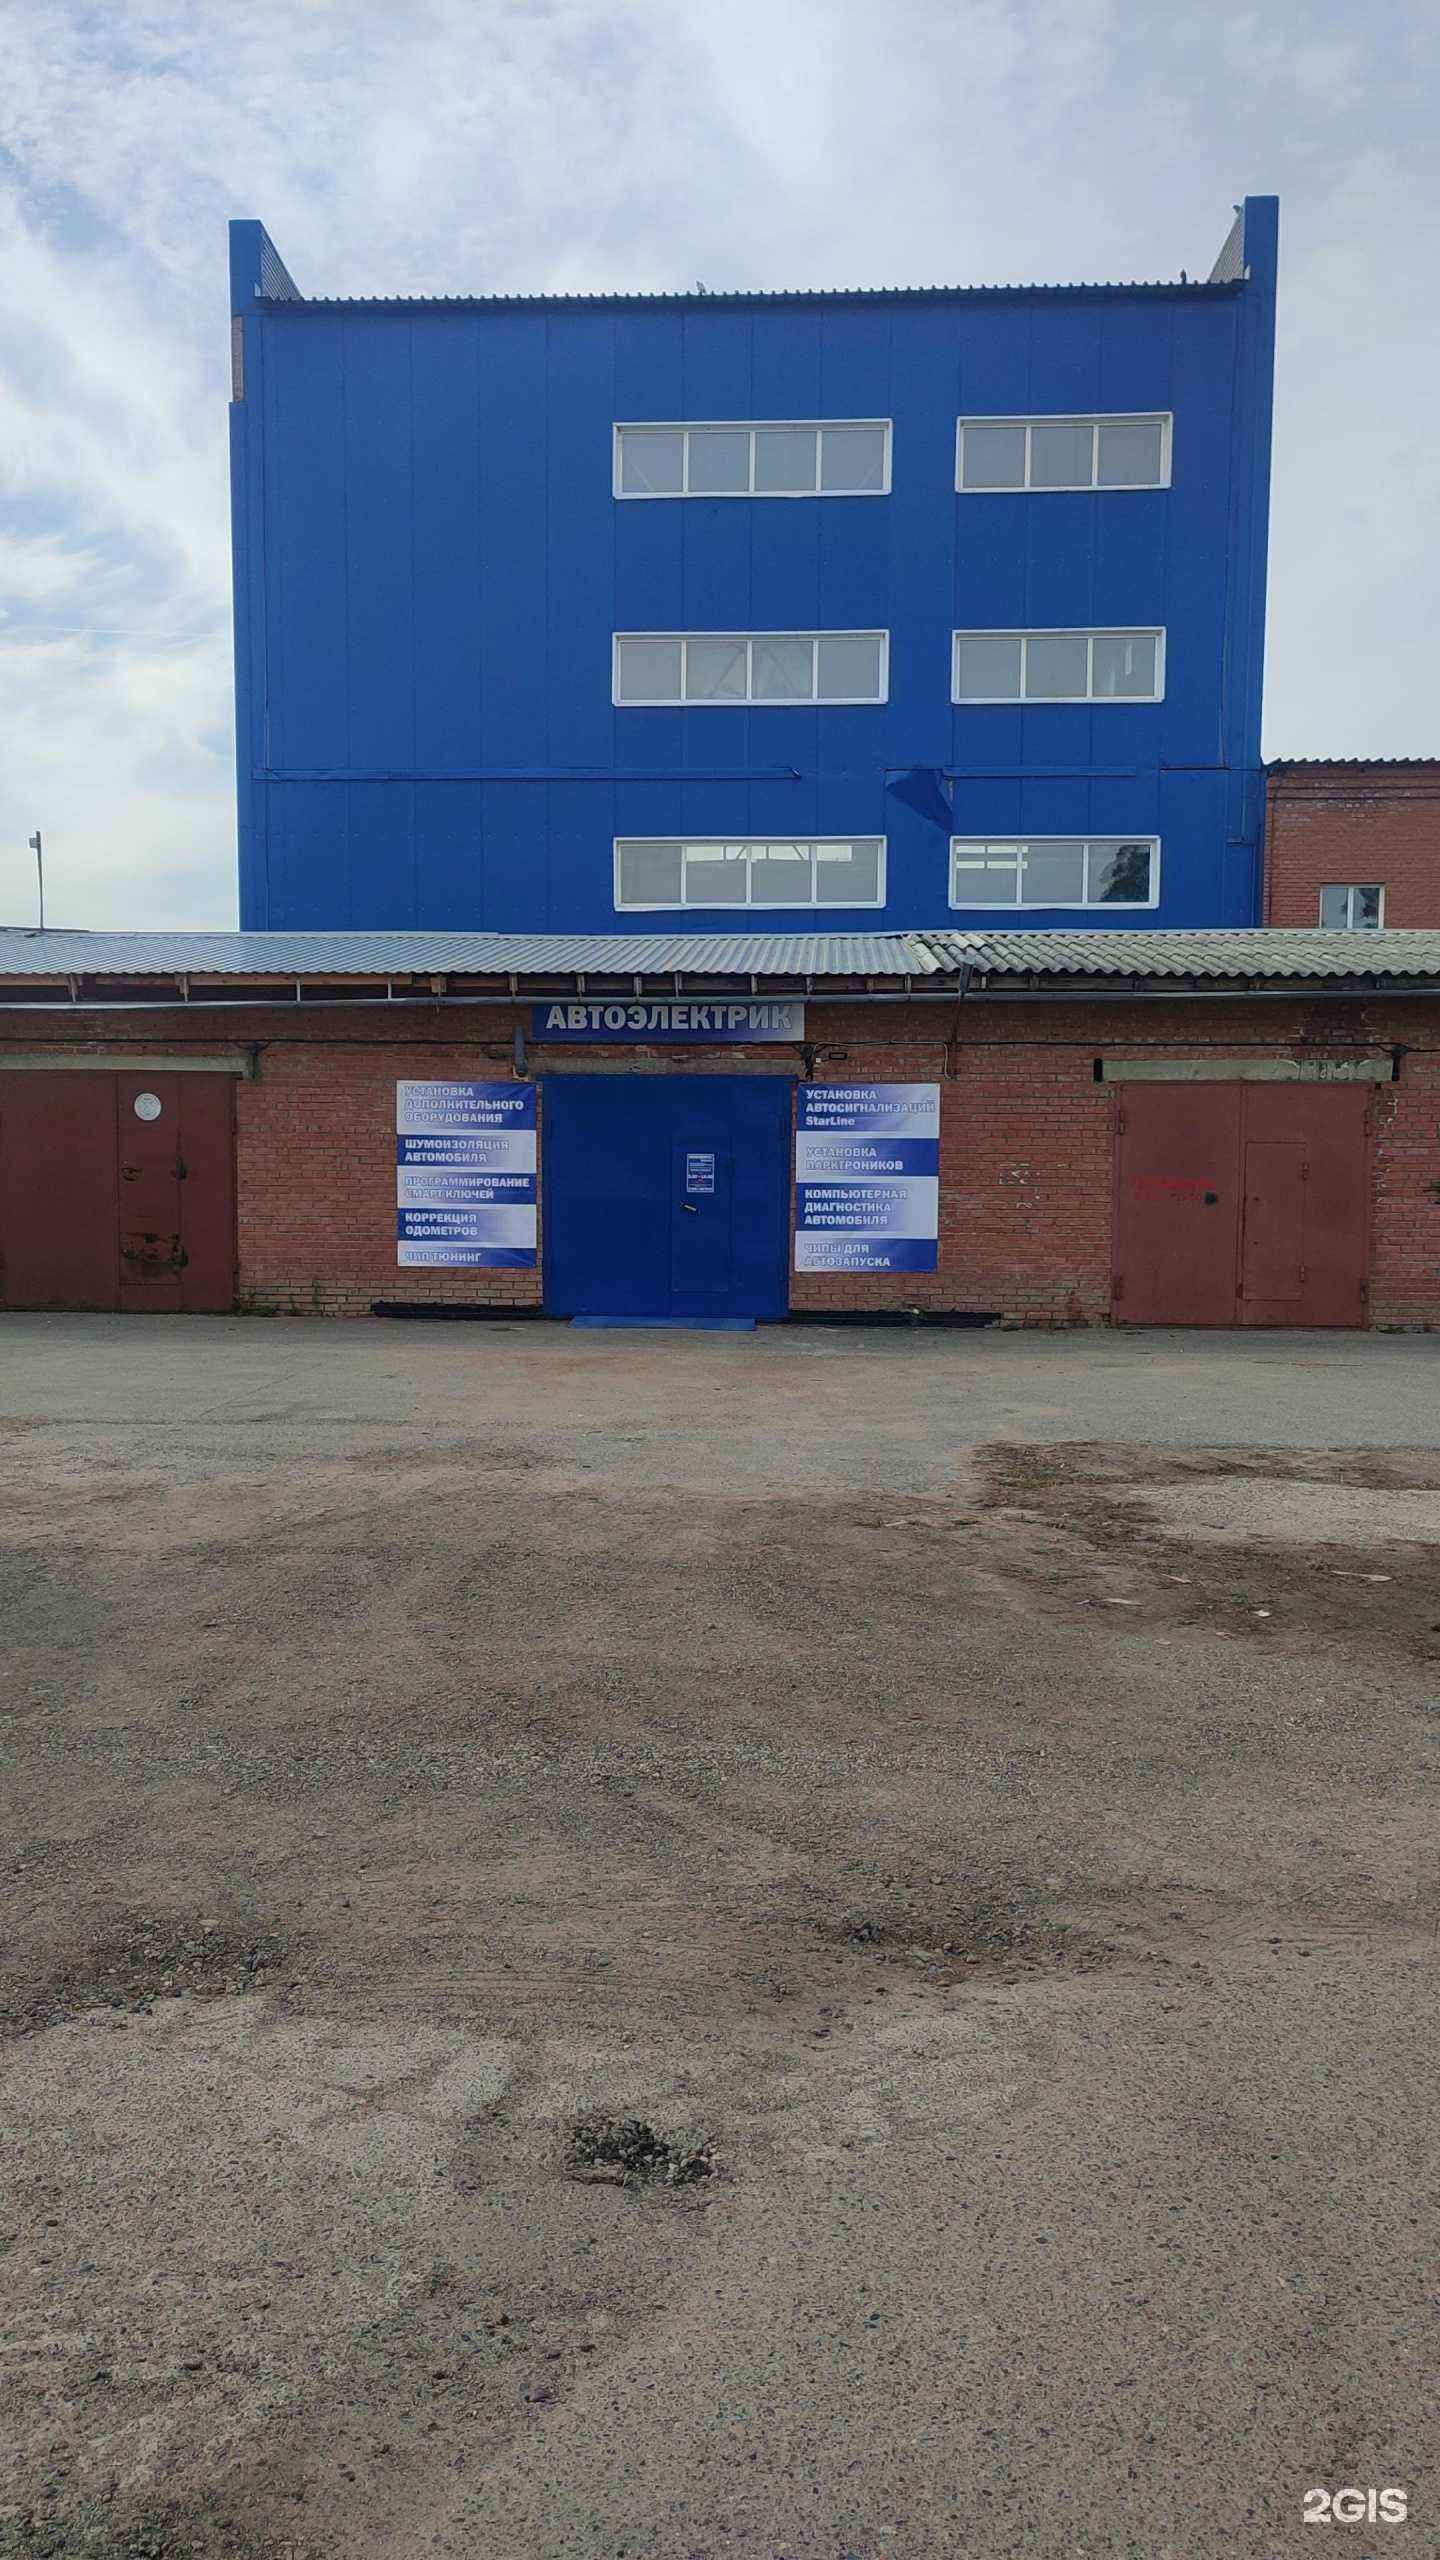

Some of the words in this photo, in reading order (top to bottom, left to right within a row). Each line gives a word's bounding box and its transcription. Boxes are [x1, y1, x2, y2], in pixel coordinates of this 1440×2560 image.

[546, 1005, 793, 1030] АВТОЭЛЕКТРИК
[404, 1087, 474, 1097] УСТАНОВКА
[806, 1090, 877, 1099] УСТАНОВКА
[404, 1100, 524, 1111] ДОПОЛНИТЕЛЬНОГО
[405, 1112, 503, 1123] ОБОРУДОВАНИЯ
[806, 1117, 855, 1126] StarLine
[405, 1139, 509, 1150] ШУМОИЗОЛЯЦИЯ
[405, 1152, 487, 1162] АВТОМОБИЛЯ
[807, 1147, 877, 1157] УСТАНОВКА
[807, 1160, 903, 1170] ПАРКТРОНИКОВ
[405, 1177, 530, 1188] ПРОГРАММИРОВАНИЕ
[406, 1189, 442, 1199] СМАРТ
[446, 1188, 494, 1199] КЛЮЧЕЙ
[805, 1189, 907, 1199] КОМПЬЮТЕРНАЯ
[804, 1202, 891, 1213] ДИАГНОСТИКА
[405, 1213, 477, 1224] КОРРЕКЦИЯ
[805, 1215, 888, 1225] АВТОМОБИЛЯ
[405, 1226, 478, 1236] ОДОМЕТРОВ
[806, 1244, 841, 1253] ЧИПЫ
[844, 1244, 869, 1254] ДЛЯ
[406, 1251, 429, 1262] ЧИП
[432, 1251, 482, 1262] ТЮНИНГ
[806, 1257, 891, 1267] АВТОЗАПУСКА
